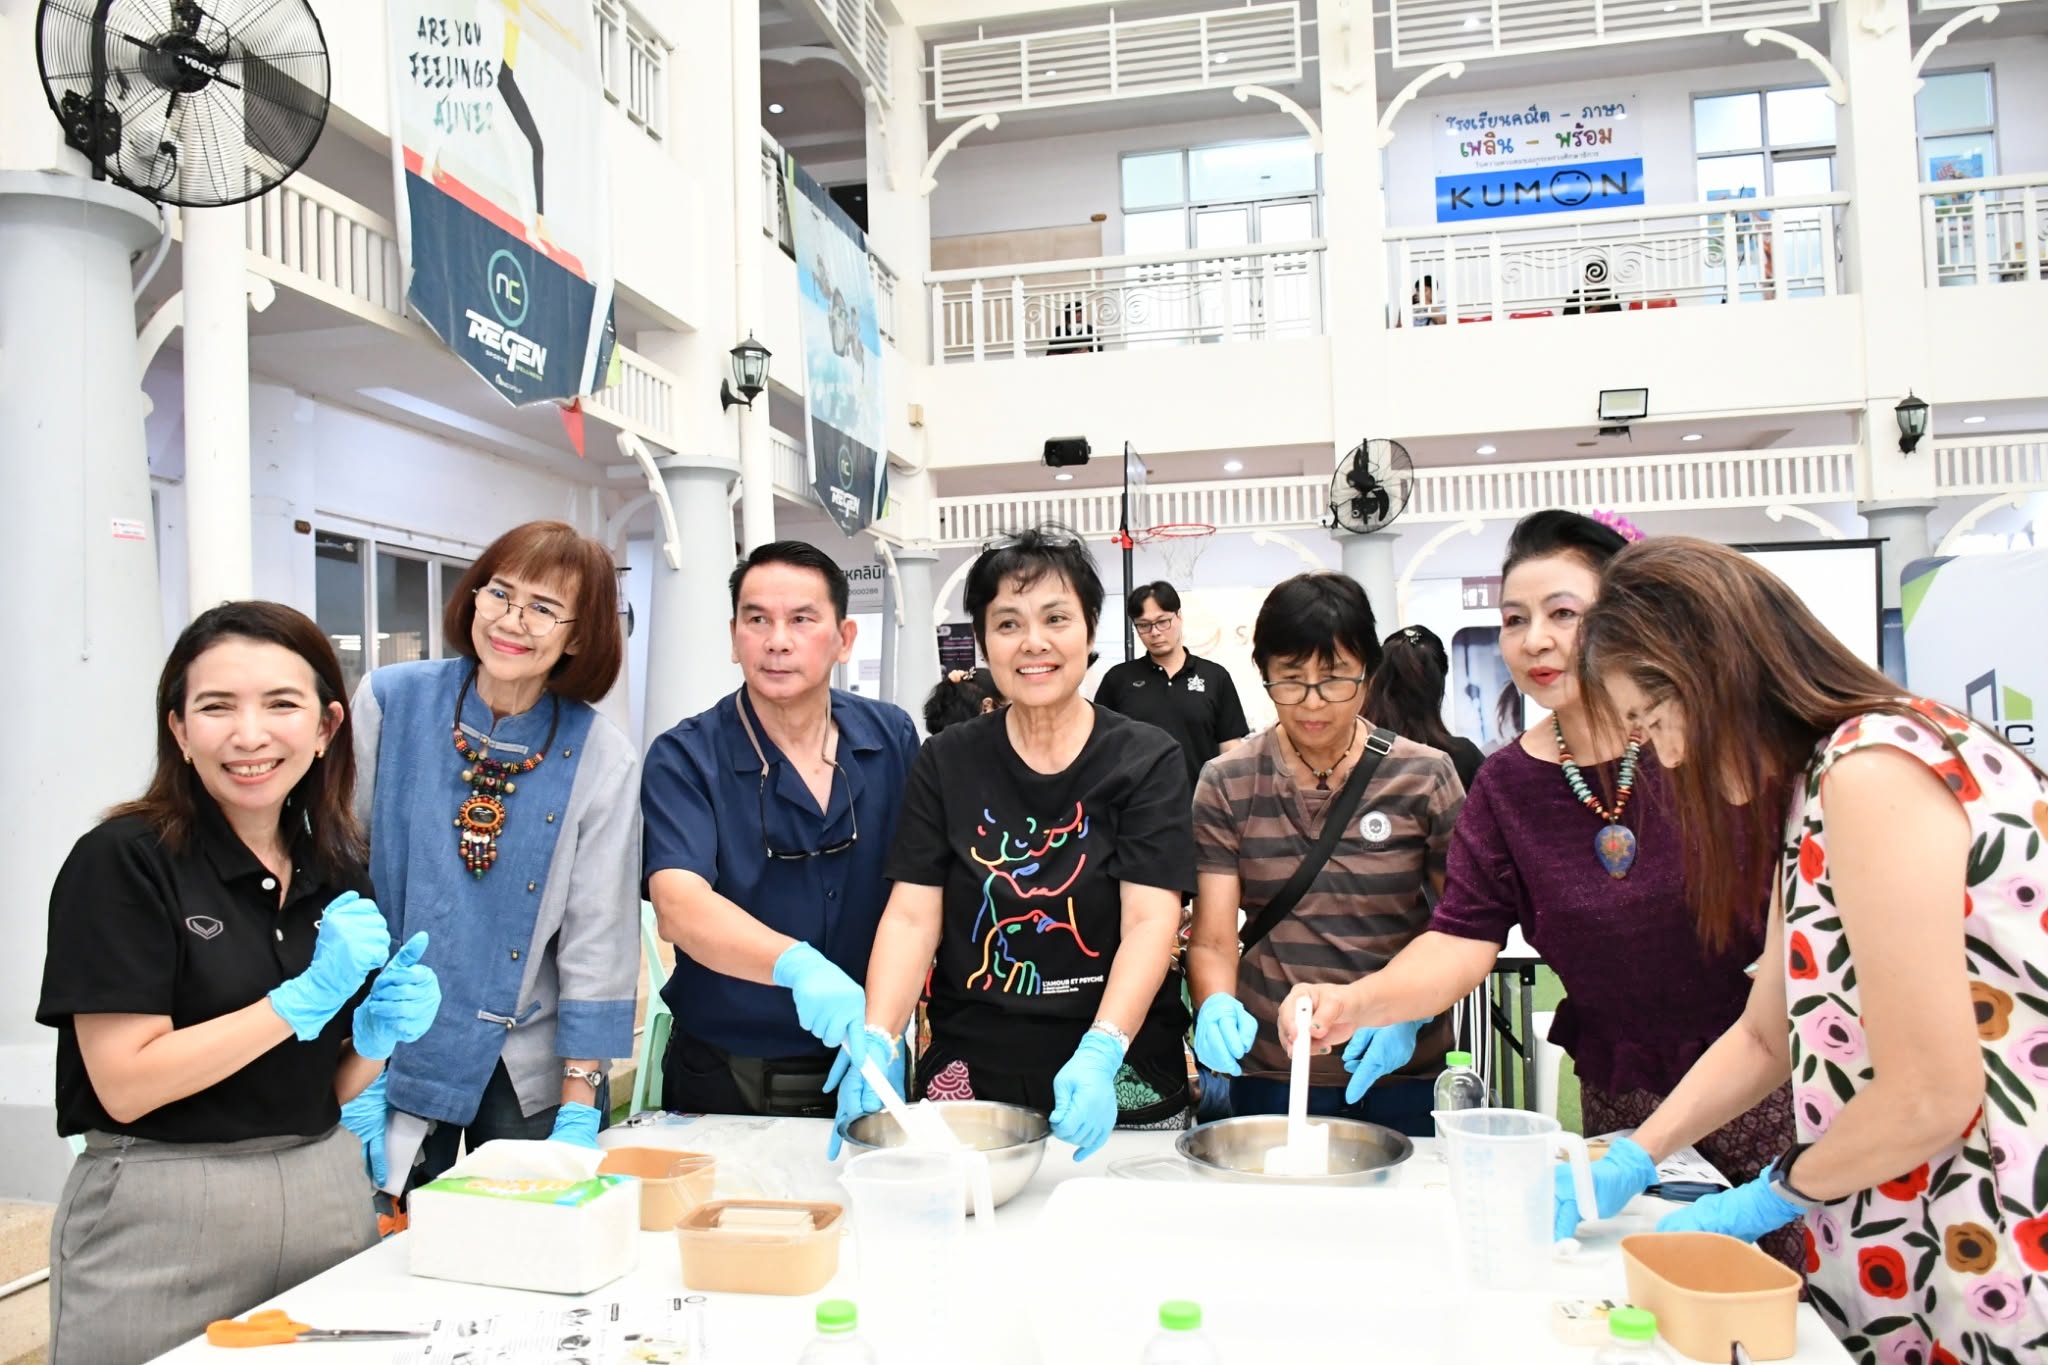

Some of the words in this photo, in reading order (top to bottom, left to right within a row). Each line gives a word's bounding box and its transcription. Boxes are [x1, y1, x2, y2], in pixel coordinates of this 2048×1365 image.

[417, 15, 450, 47] ARE
[455, 19, 482, 46] YOU
[409, 51, 494, 89] FEELINGS
[1460, 131, 1514, 158] เพลิน
[1555, 122, 1613, 149] พร้อม
[1450, 169, 1629, 211] KUMON
[465, 308, 548, 376] REGEN
